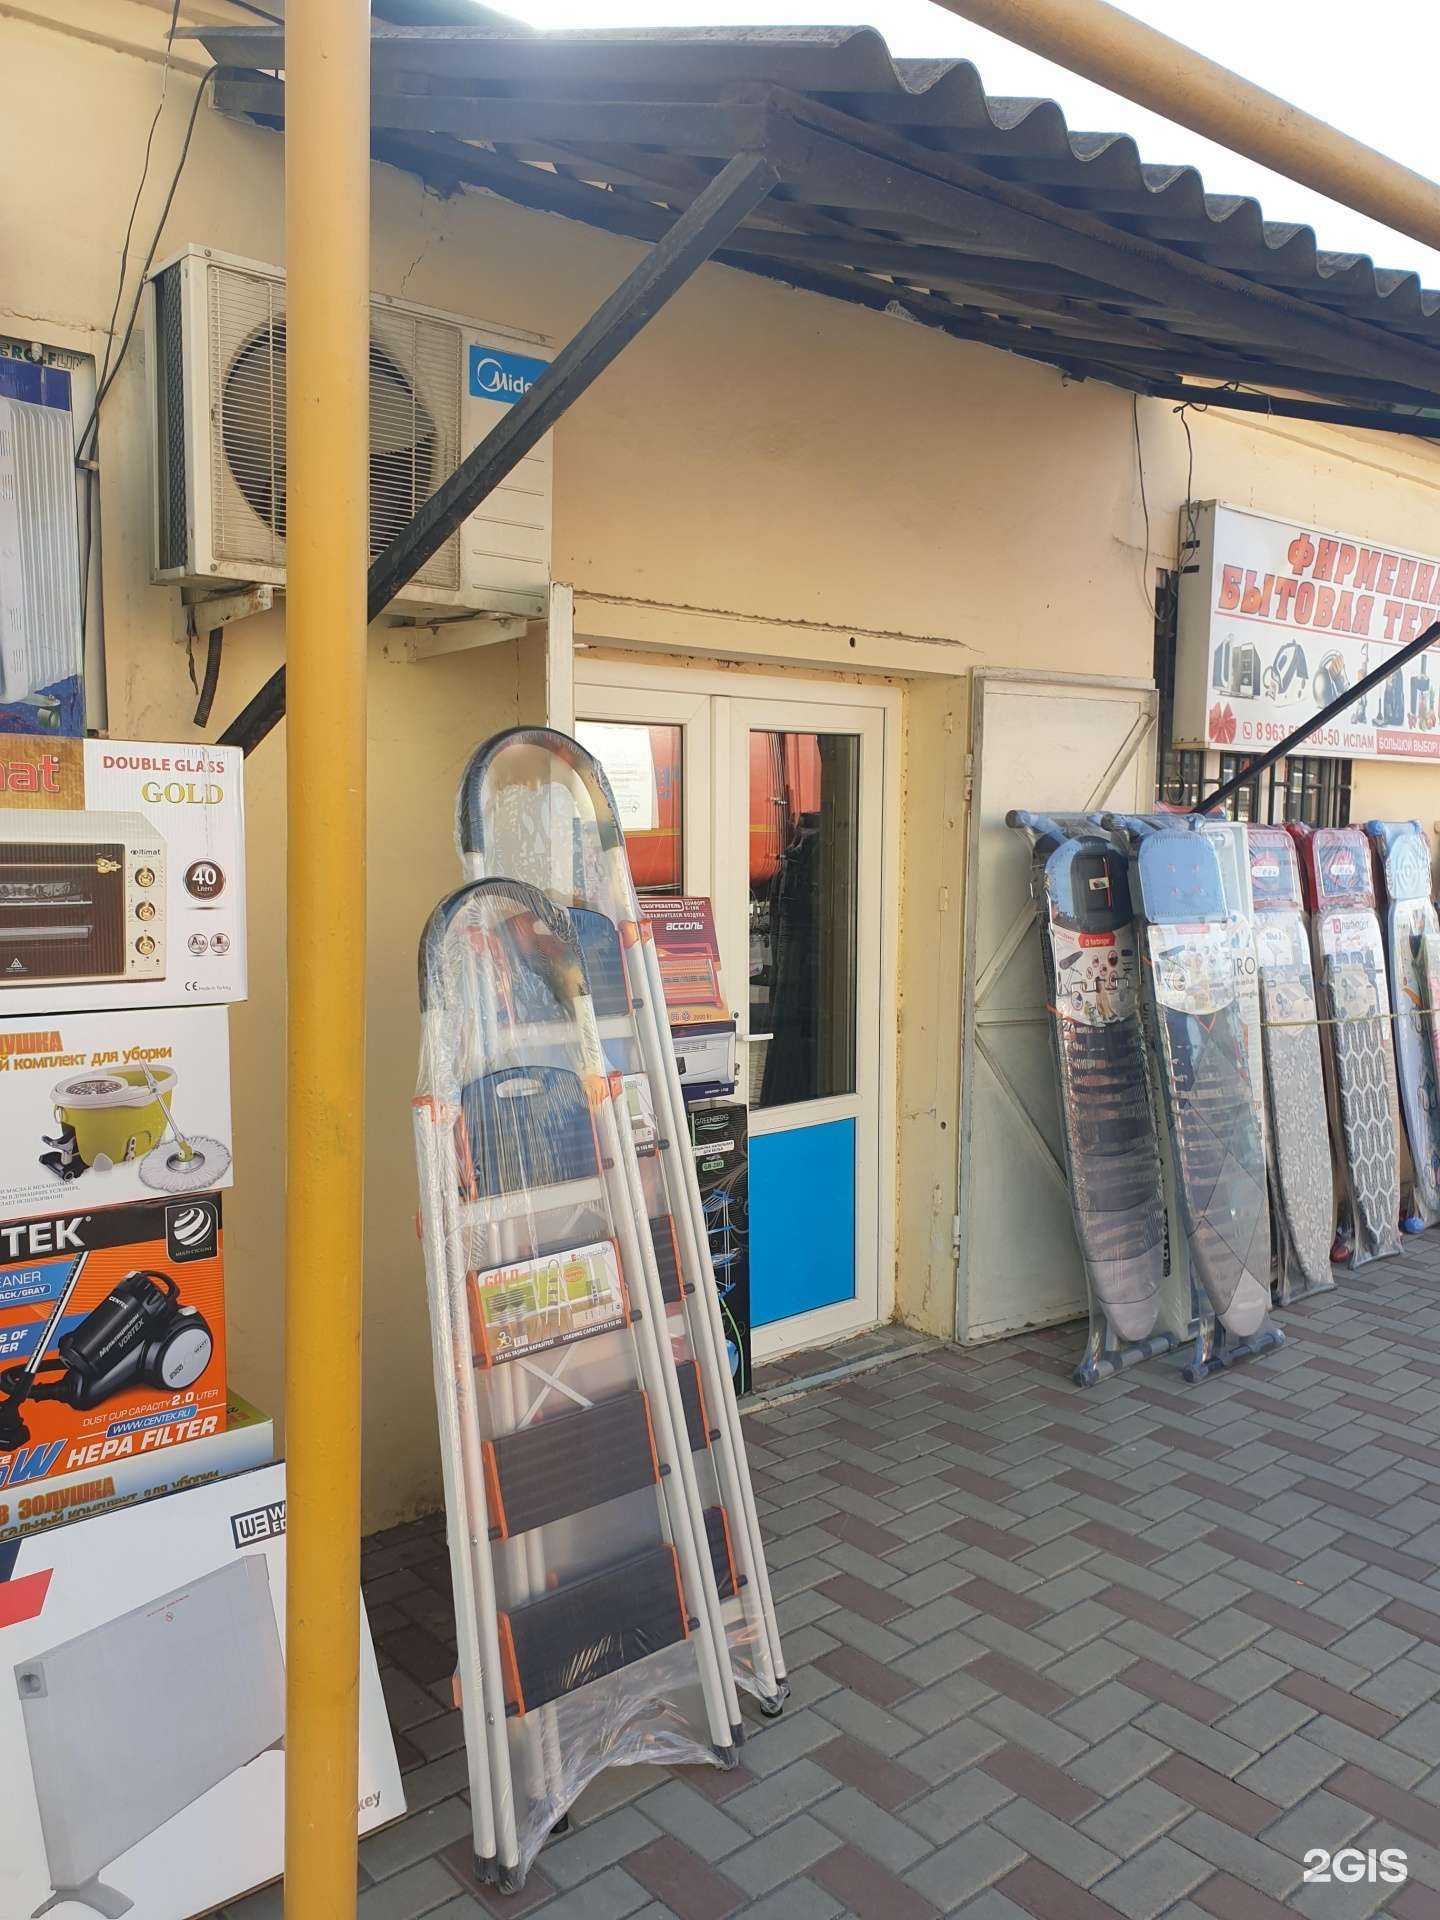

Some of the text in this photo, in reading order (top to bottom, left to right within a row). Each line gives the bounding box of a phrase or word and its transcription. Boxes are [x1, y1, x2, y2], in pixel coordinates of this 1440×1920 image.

[1218, 563, 1440, 650] БЫТОВАЯ ТЕХ
[103, 756, 225, 774] DOUBLE GLASS
[140, 781, 224, 805] GOLD
[192, 868, 217, 885] 40
[14, 1053, 87, 1070] комплект
[91, 1050, 118, 1067] для
[122, 1045, 172, 1064] уборки
[11, 1329, 28, 1341] OF
[118, 1319, 145, 1349] VORTEX
[83, 1389, 218, 1427] DUST CUP CAPACITY 2.0 LITER
[113, 1408, 191, 1435] WWW.CENTEK.RU
[66, 1415, 218, 1469] HEPA FILTER
[18, 1476, 116, 1520] ЗОЛУШКА
